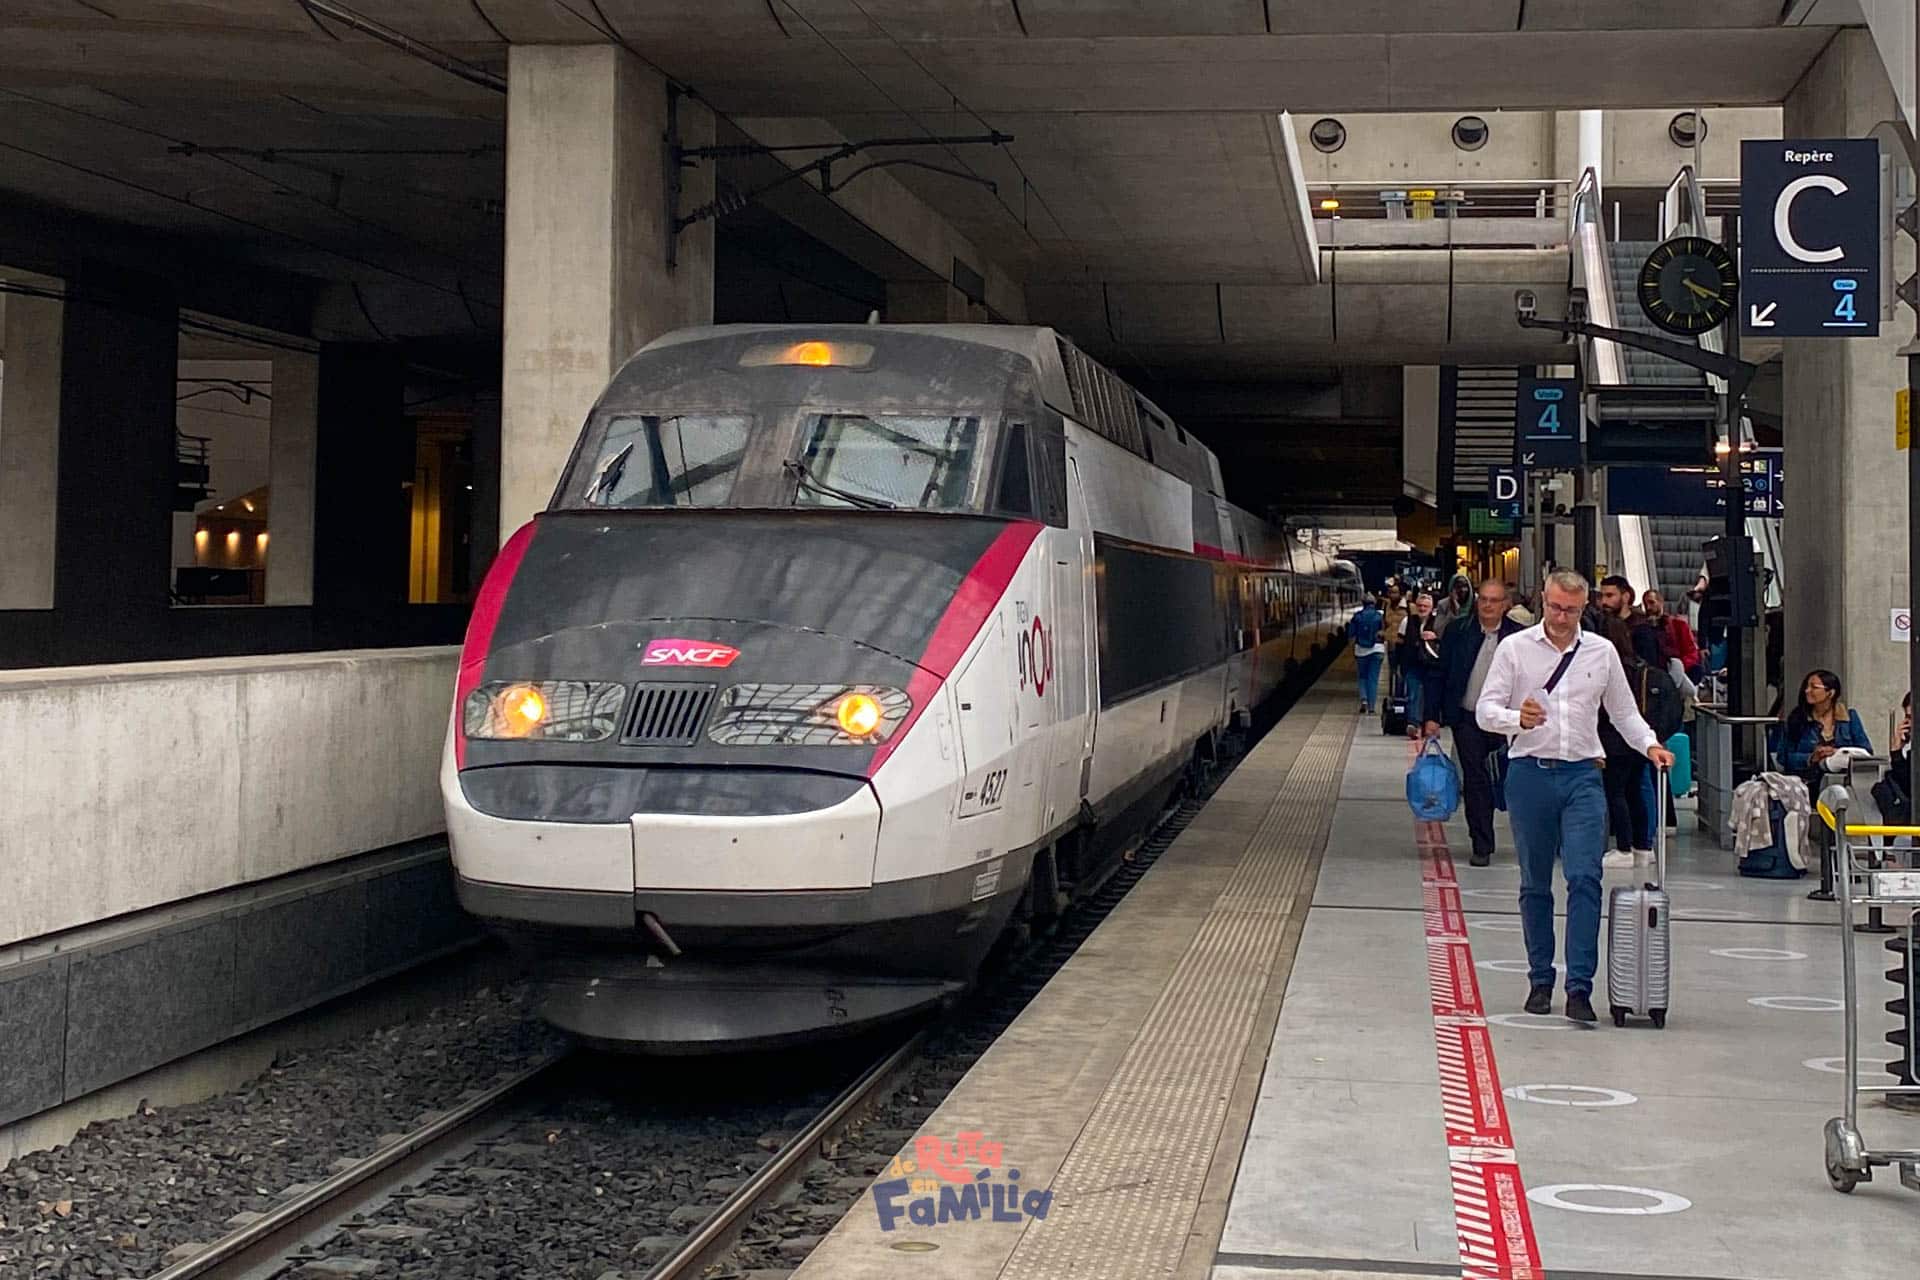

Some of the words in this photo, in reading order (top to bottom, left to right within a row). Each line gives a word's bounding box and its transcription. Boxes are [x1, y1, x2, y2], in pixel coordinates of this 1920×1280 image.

[1785, 150, 1833, 164] Repère
[1774, 175, 1849, 263] C
[1834, 293, 1856, 321] 4
[1538, 403, 1560, 433] 4
[1496, 475, 1518, 499] D
[643, 648, 732, 663] SNCF
[980, 769, 1008, 807] 4527
